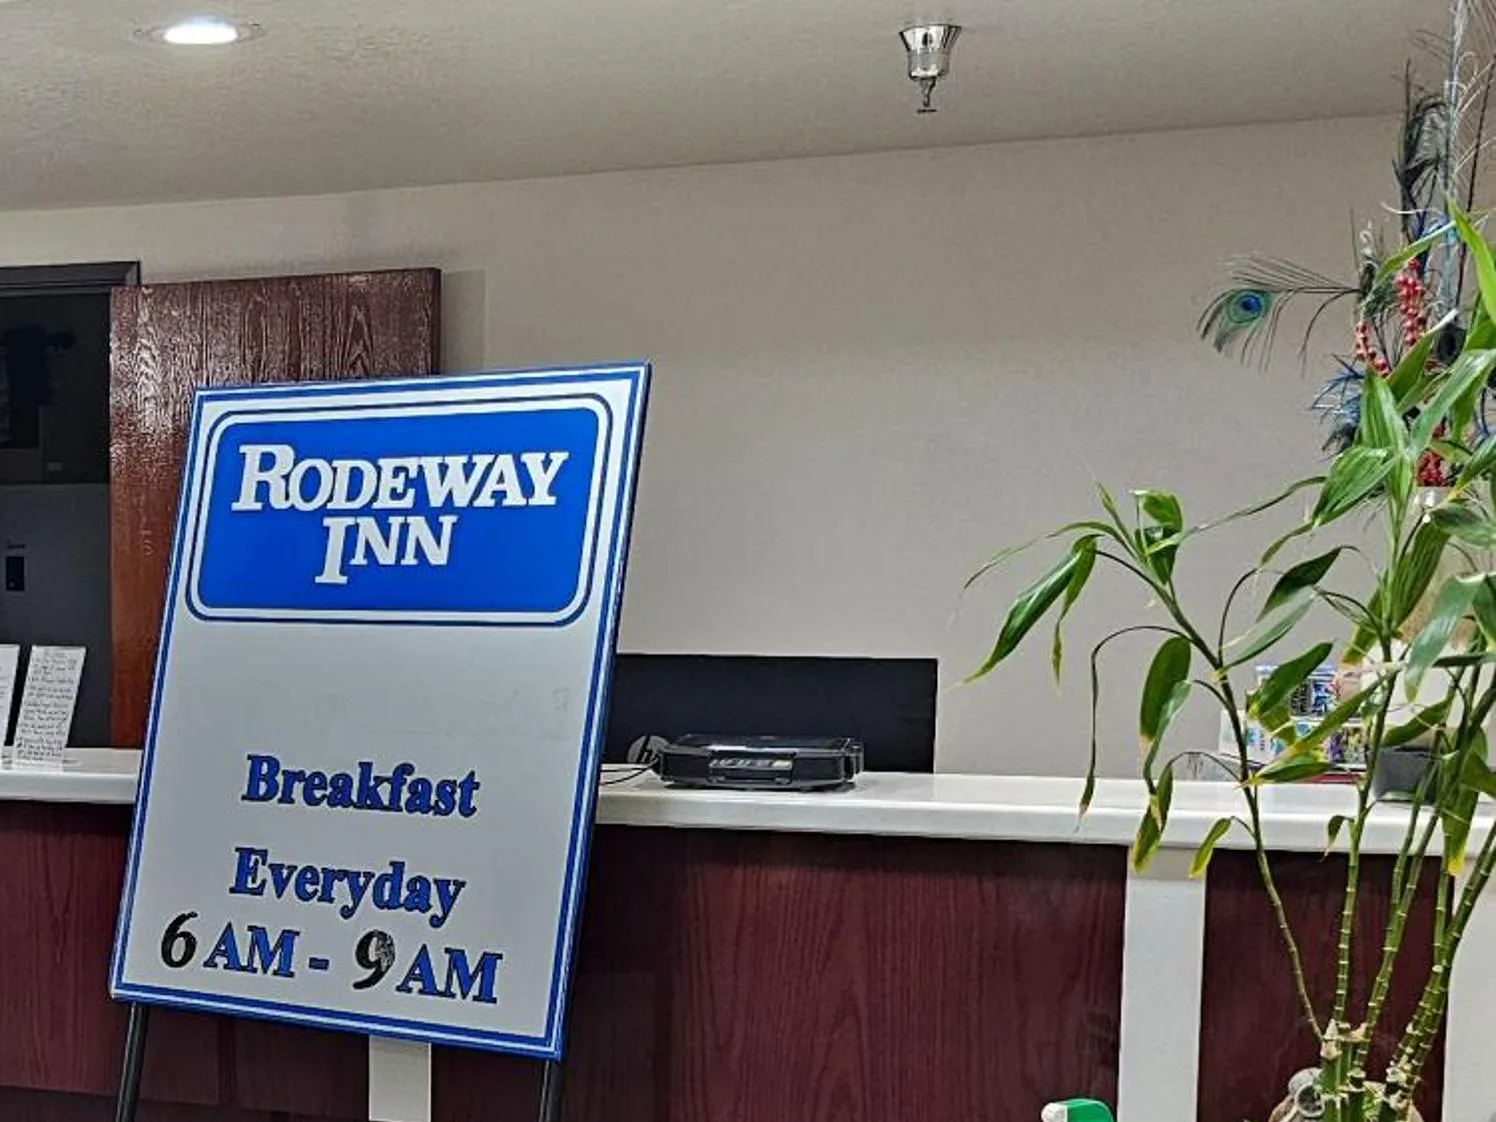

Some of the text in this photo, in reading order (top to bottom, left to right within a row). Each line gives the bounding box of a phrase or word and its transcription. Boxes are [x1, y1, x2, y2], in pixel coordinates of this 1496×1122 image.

[231, 443, 569, 513] RODEWAY
[314, 515, 458, 586] INN
[241, 754, 481, 817] Breakfast
[229, 847, 466, 928] Everyday
